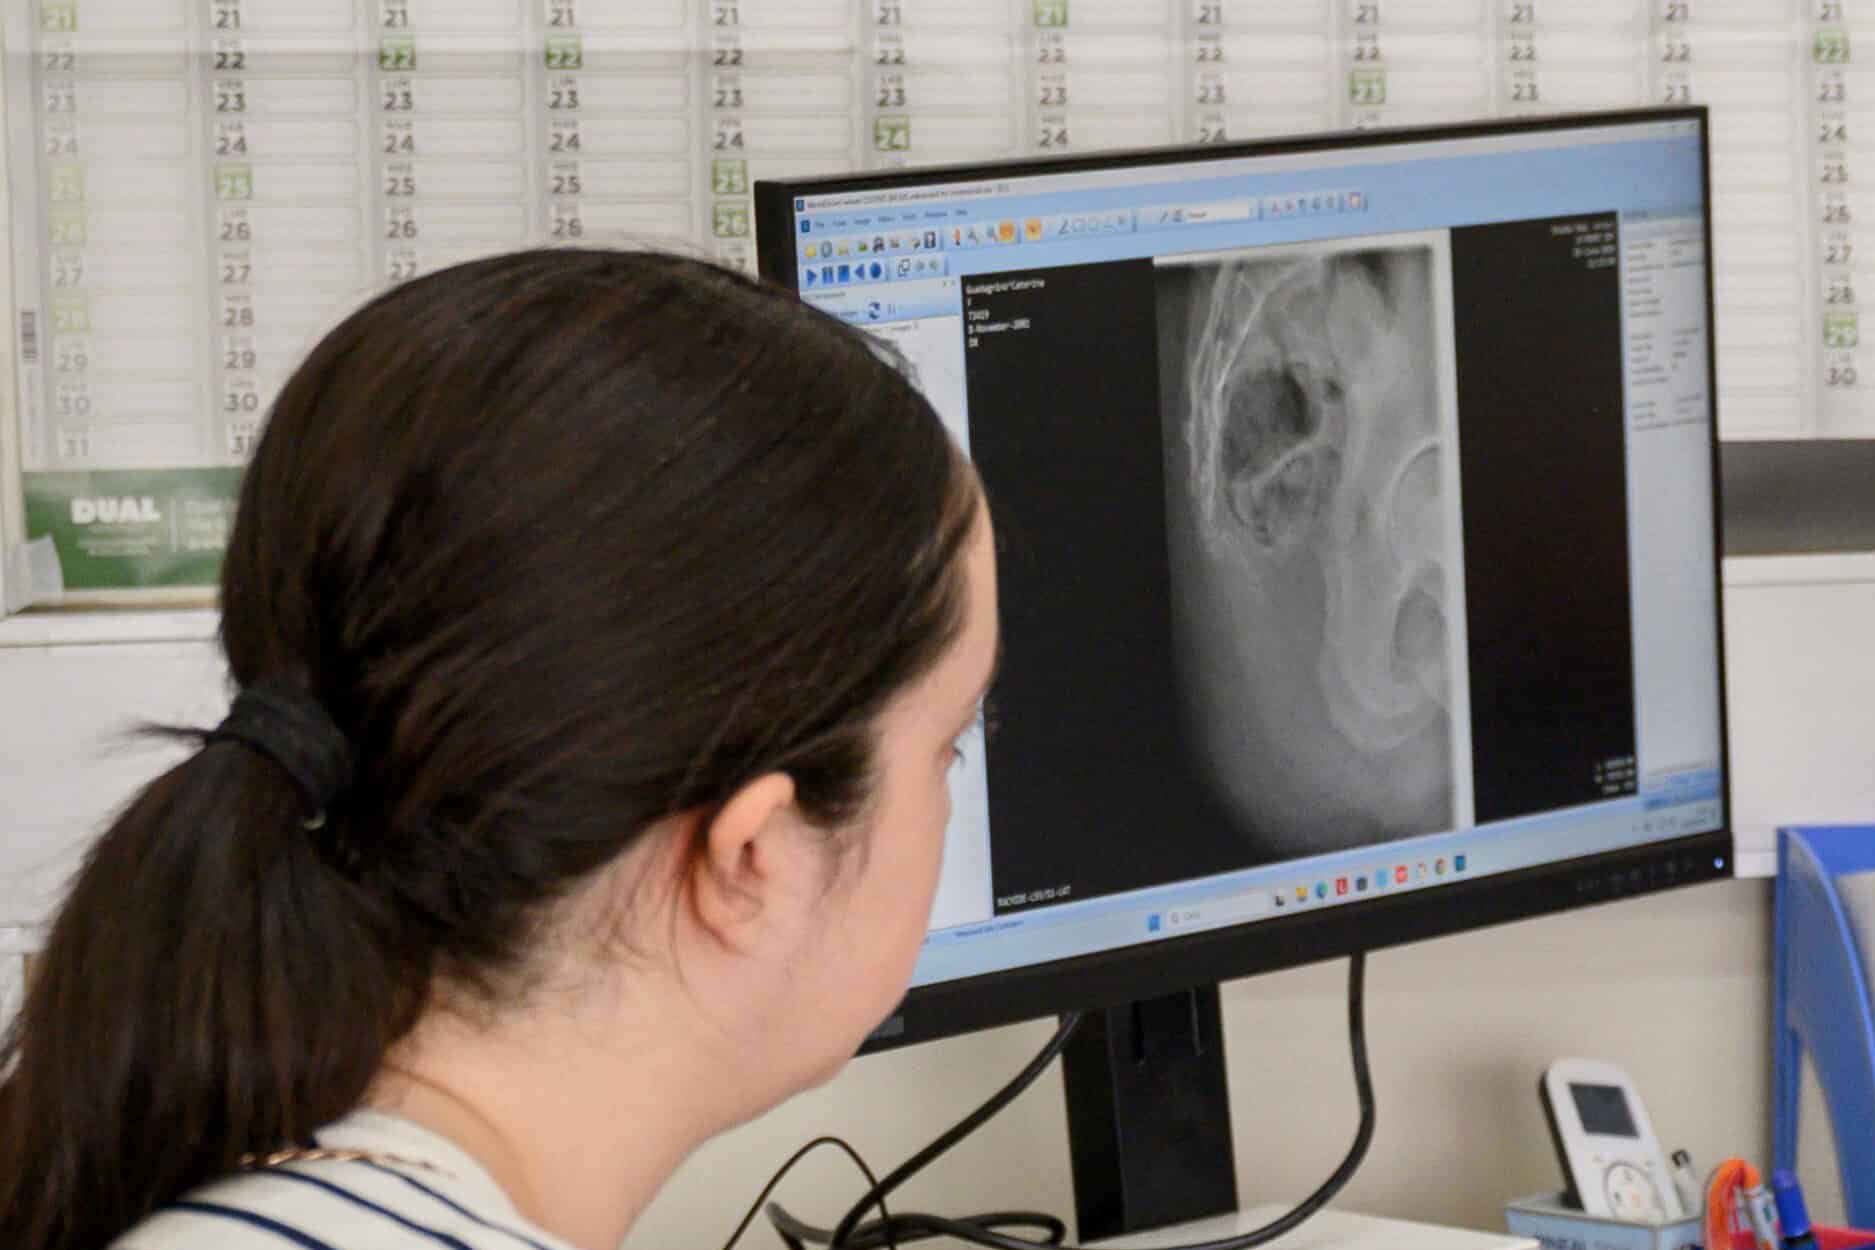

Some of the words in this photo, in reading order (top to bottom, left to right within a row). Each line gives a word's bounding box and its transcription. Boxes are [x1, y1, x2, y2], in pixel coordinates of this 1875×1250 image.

[215, 9, 241, 29] 21
[384, 8, 408, 27] 21
[551, 8, 574, 27] 21
[715, 8, 739, 26] 21
[878, 7, 901, 25] 21
[1199, 6, 1223, 24] 21
[1355, 5, 1380, 24] 21
[1510, 4, 1535, 22] 21
[1664, 4, 1690, 22] 21
[214, 52, 246, 70] 22
[714, 49, 742, 66] 22
[877, 49, 905, 65] 22
[1038, 49, 1066, 64] 22
[1197, 47, 1225, 62] 22
[1354, 47, 1381, 61] 22
[1509, 44, 1537, 62] 22
[1663, 44, 1691, 62] 22
[216, 92, 247, 112] 23
[384, 91, 413, 111] 23
[550, 90, 578, 109] 23
[714, 89, 743, 108] 23
[878, 88, 906, 107] 23
[1039, 87, 1067, 105] 23
[551, 133, 581, 152] 24
[714, 132, 744, 150] 24
[1039, 129, 1068, 148] 24
[1818, 124, 1848, 144] 24
[216, 136, 248, 156] 24
[385, 135, 415, 154] 24
[385, 177, 415, 196] 25
[552, 175, 582, 195] 25
[220, 222, 251, 241] 26
[387, 220, 417, 240] 26
[553, 218, 583, 238] 26
[1824, 244, 1854, 265] 27
[222, 264, 252, 284] 27
[224, 308, 255, 327] 28
[224, 350, 257, 370] 29
[1825, 367, 1857, 386] 30
[224, 393, 259, 412] 30
[71, 498, 161, 525] DUAL
